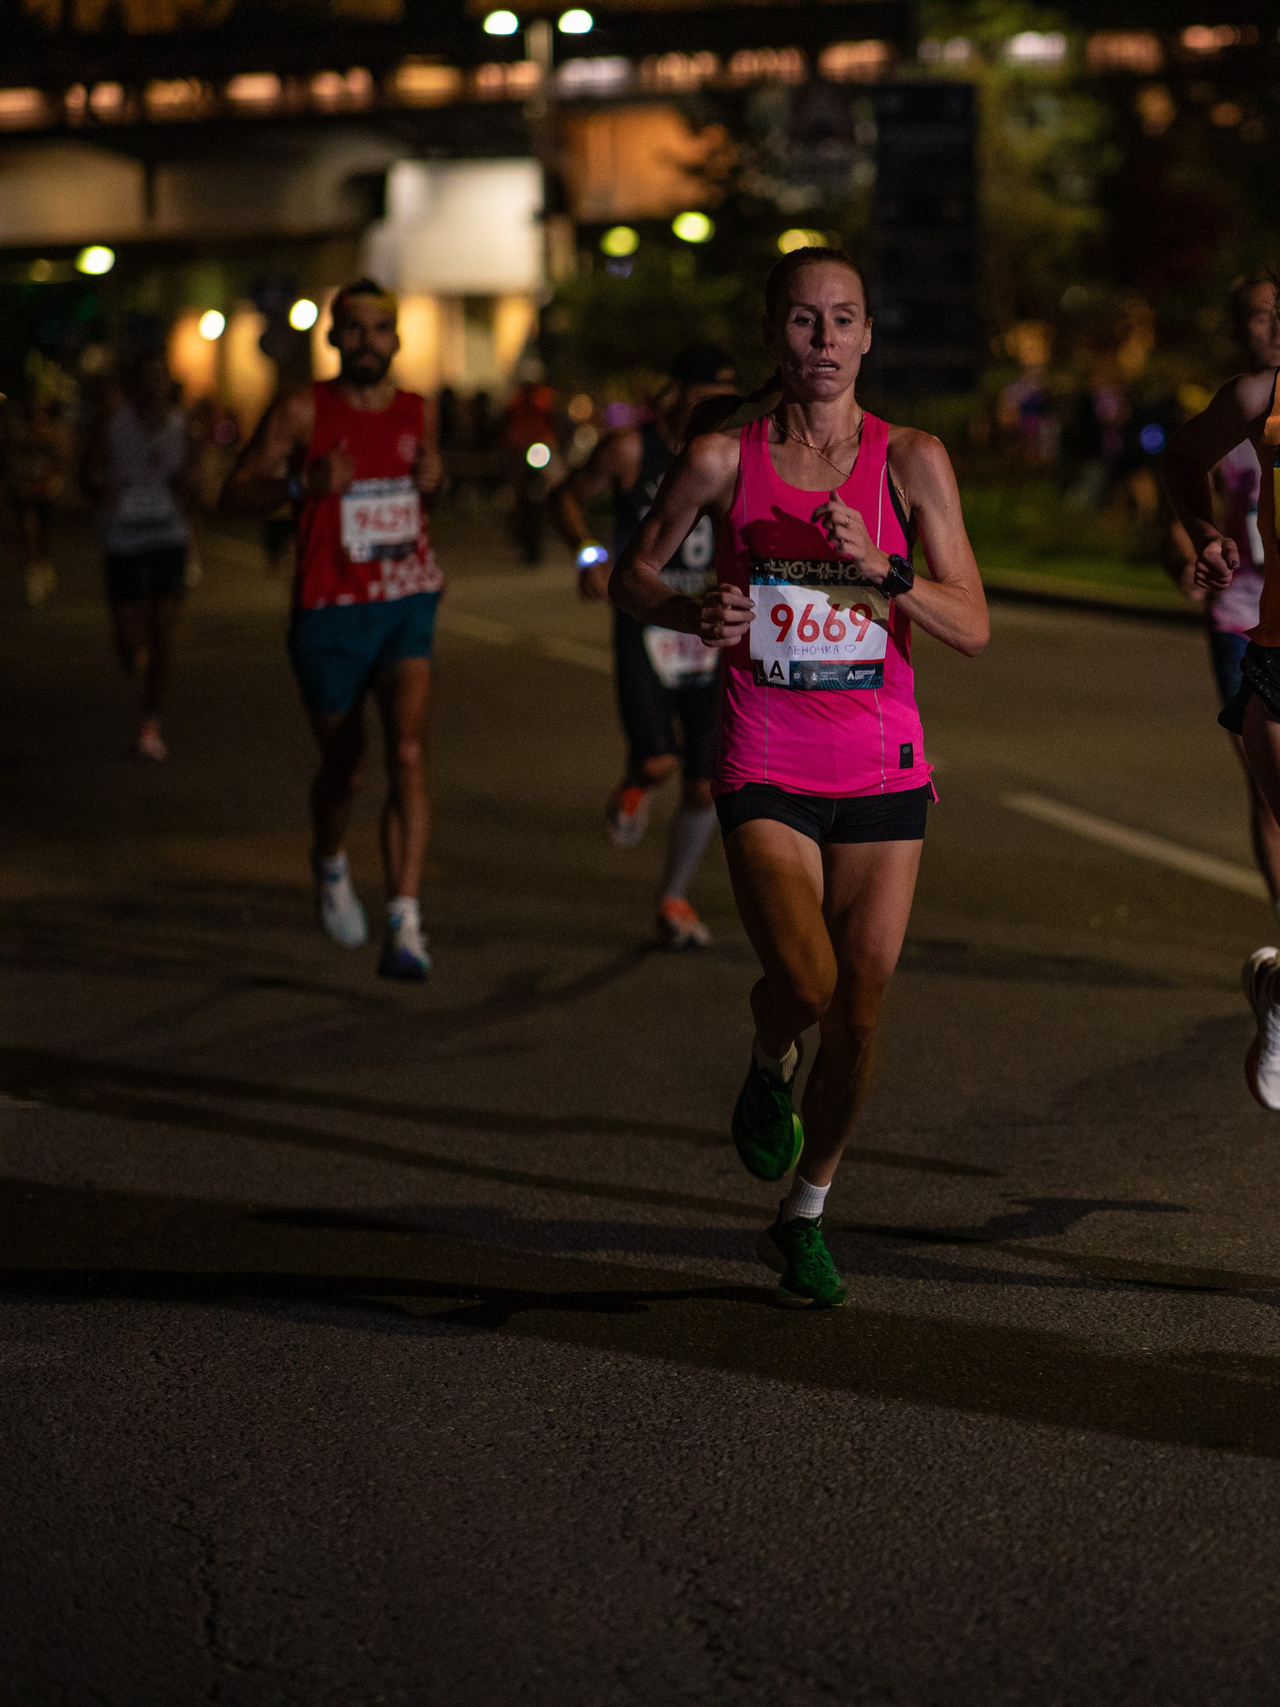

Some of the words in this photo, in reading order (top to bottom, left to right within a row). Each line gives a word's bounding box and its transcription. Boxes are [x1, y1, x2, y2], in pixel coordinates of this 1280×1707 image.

[770, 603, 873, 643] 9669
[787, 645, 839, 655] ЛЕНОЧКА
[769, 660, 785, 680] A
